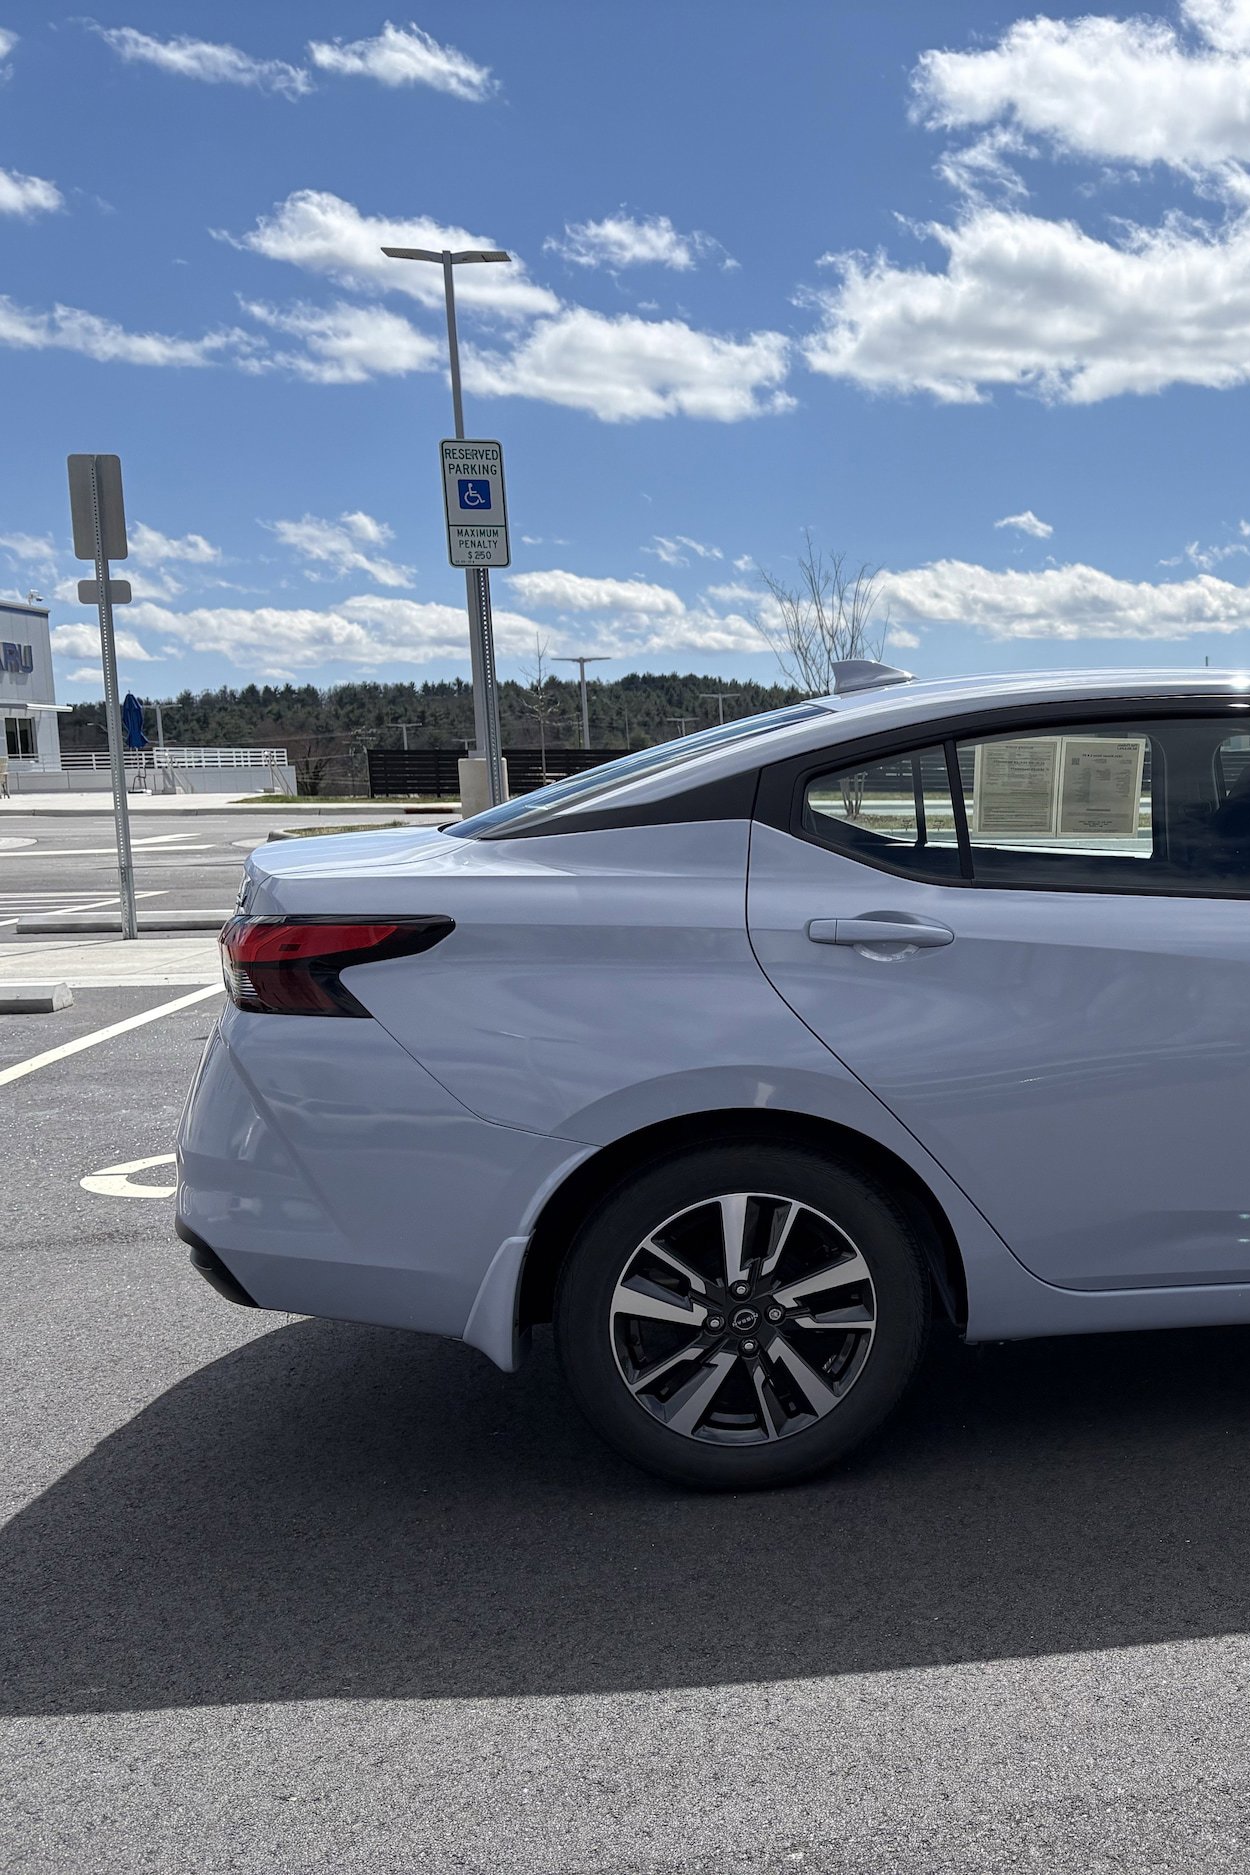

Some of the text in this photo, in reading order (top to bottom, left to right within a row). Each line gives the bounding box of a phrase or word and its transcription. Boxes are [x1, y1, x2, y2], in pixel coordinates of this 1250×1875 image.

[445, 448, 498, 460] RESERVED
[448, 463, 497, 475] PARKING
[457, 528, 499, 538] MAXIMUM
[458, 539, 498, 549] PENALTY
[467, 550, 492, 560] $250
[0, 642, 34, 673] RU
